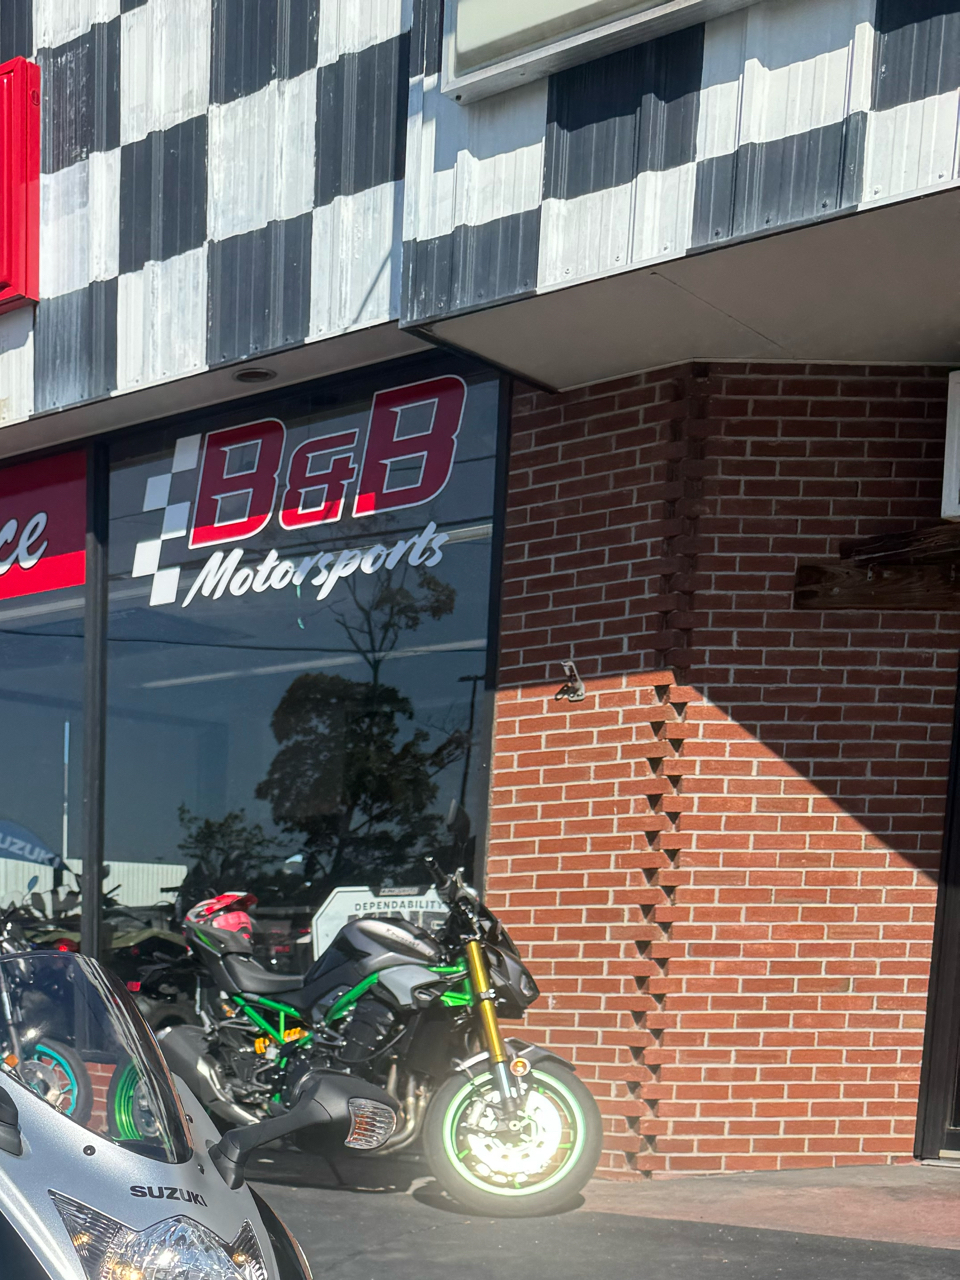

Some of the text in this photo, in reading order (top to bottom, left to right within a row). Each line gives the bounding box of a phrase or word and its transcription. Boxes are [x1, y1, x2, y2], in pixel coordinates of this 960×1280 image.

[188, 374, 467, 549] B&B
[181, 521, 450, 608] Motorsports
[354, 899, 443, 912] DEPENDABILITY
[129, 1185, 208, 1207] SUZUKI
